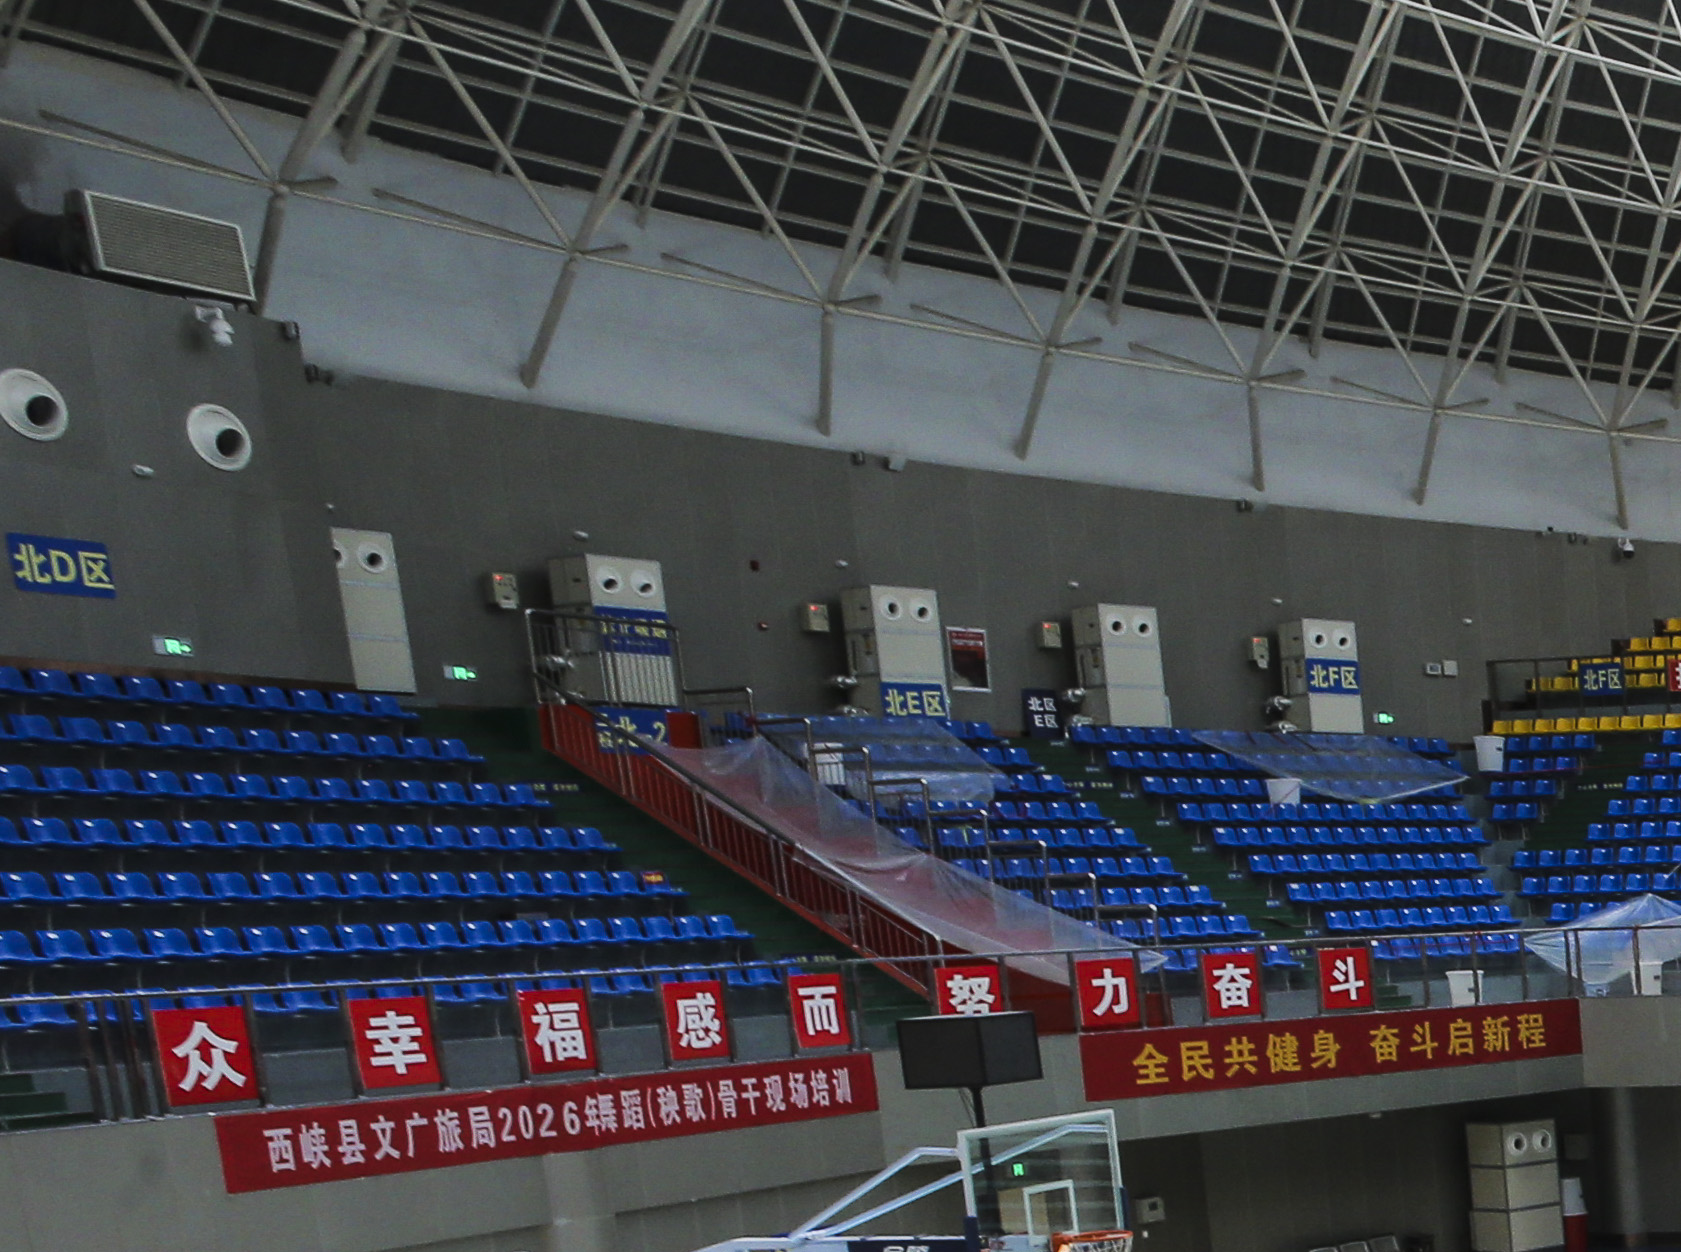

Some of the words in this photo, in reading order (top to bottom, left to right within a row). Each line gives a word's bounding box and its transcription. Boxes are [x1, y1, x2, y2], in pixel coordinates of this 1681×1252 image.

[13, 543, 116, 590] 北D区
[1310, 664, 1358, 689] 北F区
[1583, 668, 1622, 690] 北F区
[885, 688, 946, 716] 北E区
[172, 1022, 246, 1091] 众
[365, 1011, 427, 1074] 幸
[531, 1003, 587, 1062] 福
[677, 993, 722, 1048] 感
[798, 986, 840, 1035] 而
[946, 974, 996, 1013] 努
[1091, 967, 1129, 1016] 力
[1213, 964, 1253, 1008] 奋
[1330, 957, 1365, 1000] 斗
[1132, 1030, 1341, 1085] 全民共健身
[1369, 1013, 1547, 1064] 奋斗启新程
